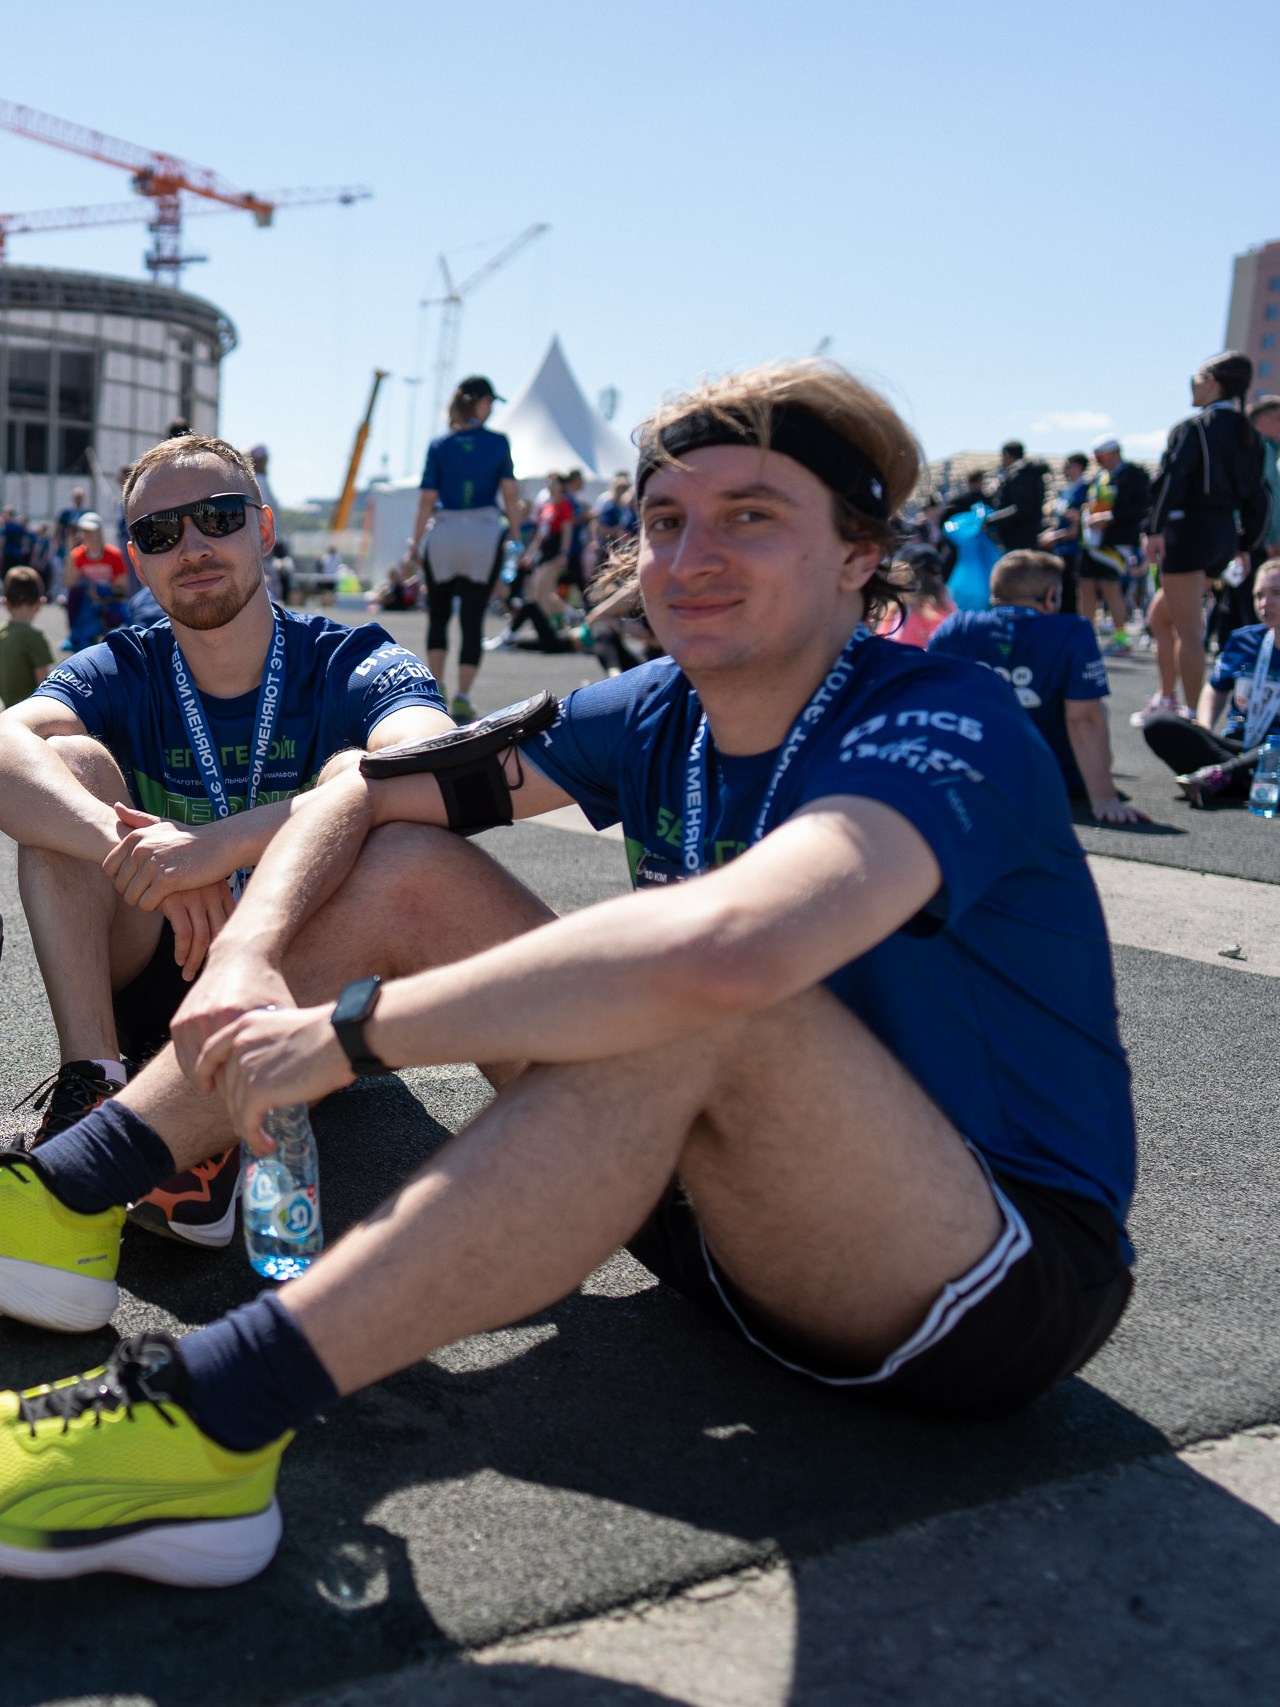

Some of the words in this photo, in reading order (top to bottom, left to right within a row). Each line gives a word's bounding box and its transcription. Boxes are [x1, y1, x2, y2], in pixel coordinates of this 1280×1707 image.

[255, 672, 280, 758] МЕНЯЮТ
[183, 698, 218, 778] МЕНЯЮТ
[210, 781, 229, 817] ЭТО
[221, 736, 295, 765] ГЕОЙ!
[249, 759, 265, 810] ЕРОИ
[264, 770, 298, 780] УМАРАФОН
[685, 766, 702, 872] МЕНЯЮ
